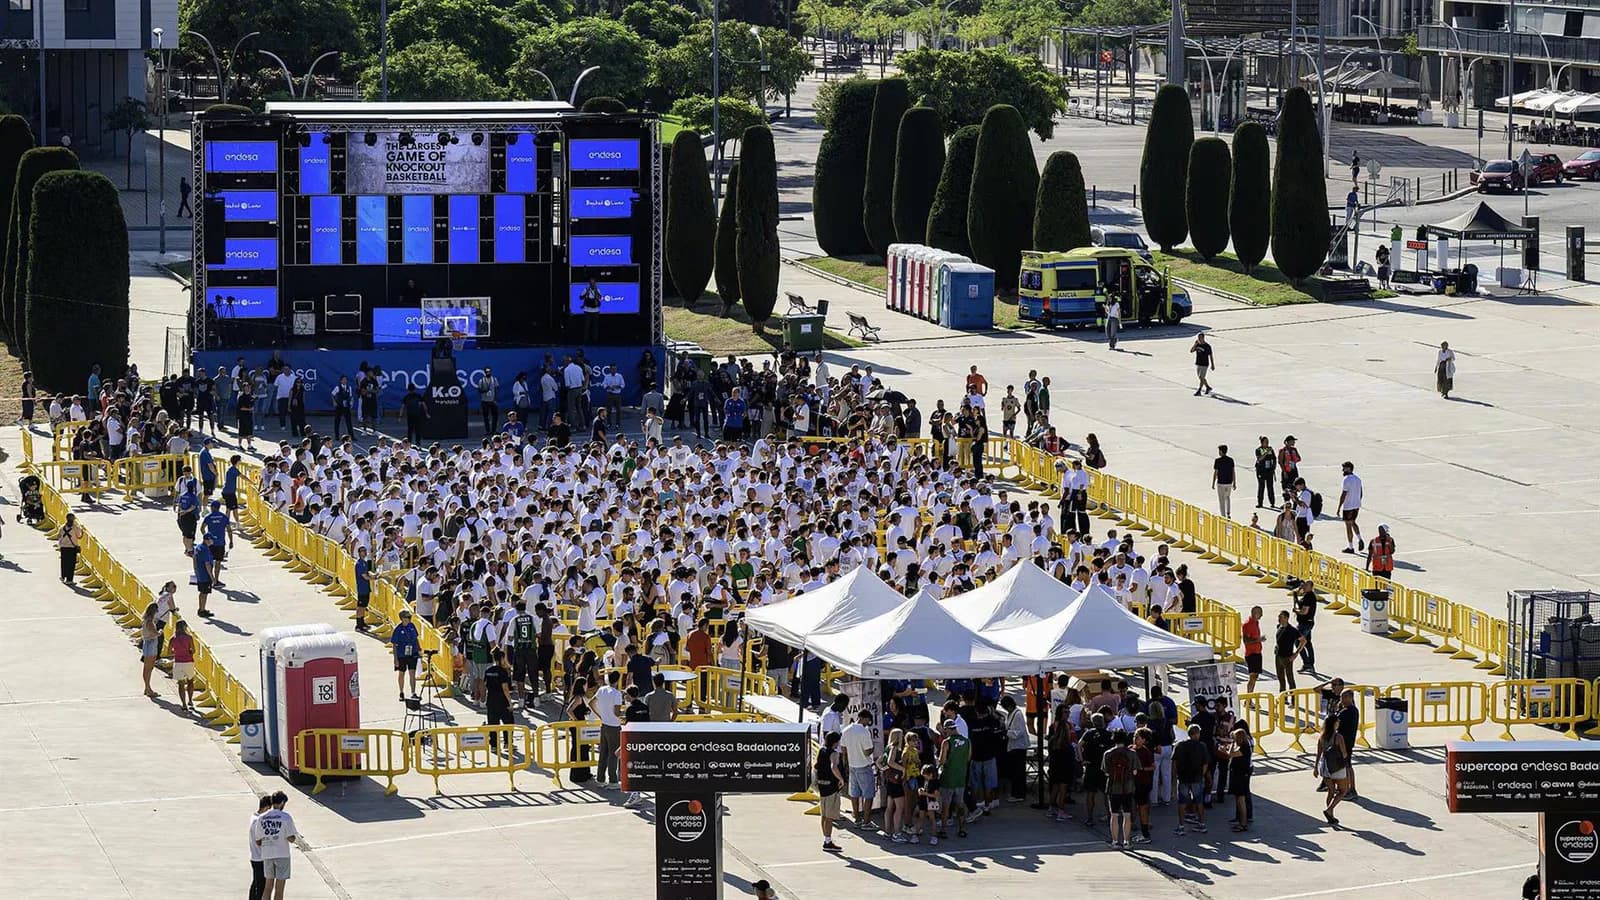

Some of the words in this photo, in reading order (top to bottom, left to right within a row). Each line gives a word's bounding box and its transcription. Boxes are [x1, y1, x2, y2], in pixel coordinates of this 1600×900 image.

[224, 152, 258, 161] endesa
[386, 151, 426, 162] GAME
[428, 151, 447, 162] OF
[588, 151, 622, 159] endesa
[386, 162, 447, 172] KNOCKOUT
[386, 172, 447, 181] BASKETBALL
[225, 250, 259, 259] endesa
[588, 248, 622, 256] endesa
[432, 385, 462, 398] K.O
[521, 625, 528, 638] 9
[1194, 684, 1233, 695] VALIDA
[318, 692, 334, 700] TOI
[626, 742, 687, 752] supercopa
[689, 741, 734, 752] endesa
[736, 742, 800, 752] Badalona'26
[666, 761, 701, 769] endesa
[1455, 762, 1518, 772] supercopa
[1520, 760, 1568, 771] endesa
[1570, 761, 1600, 771] Bada
[1497, 780, 1533, 789] endesa
